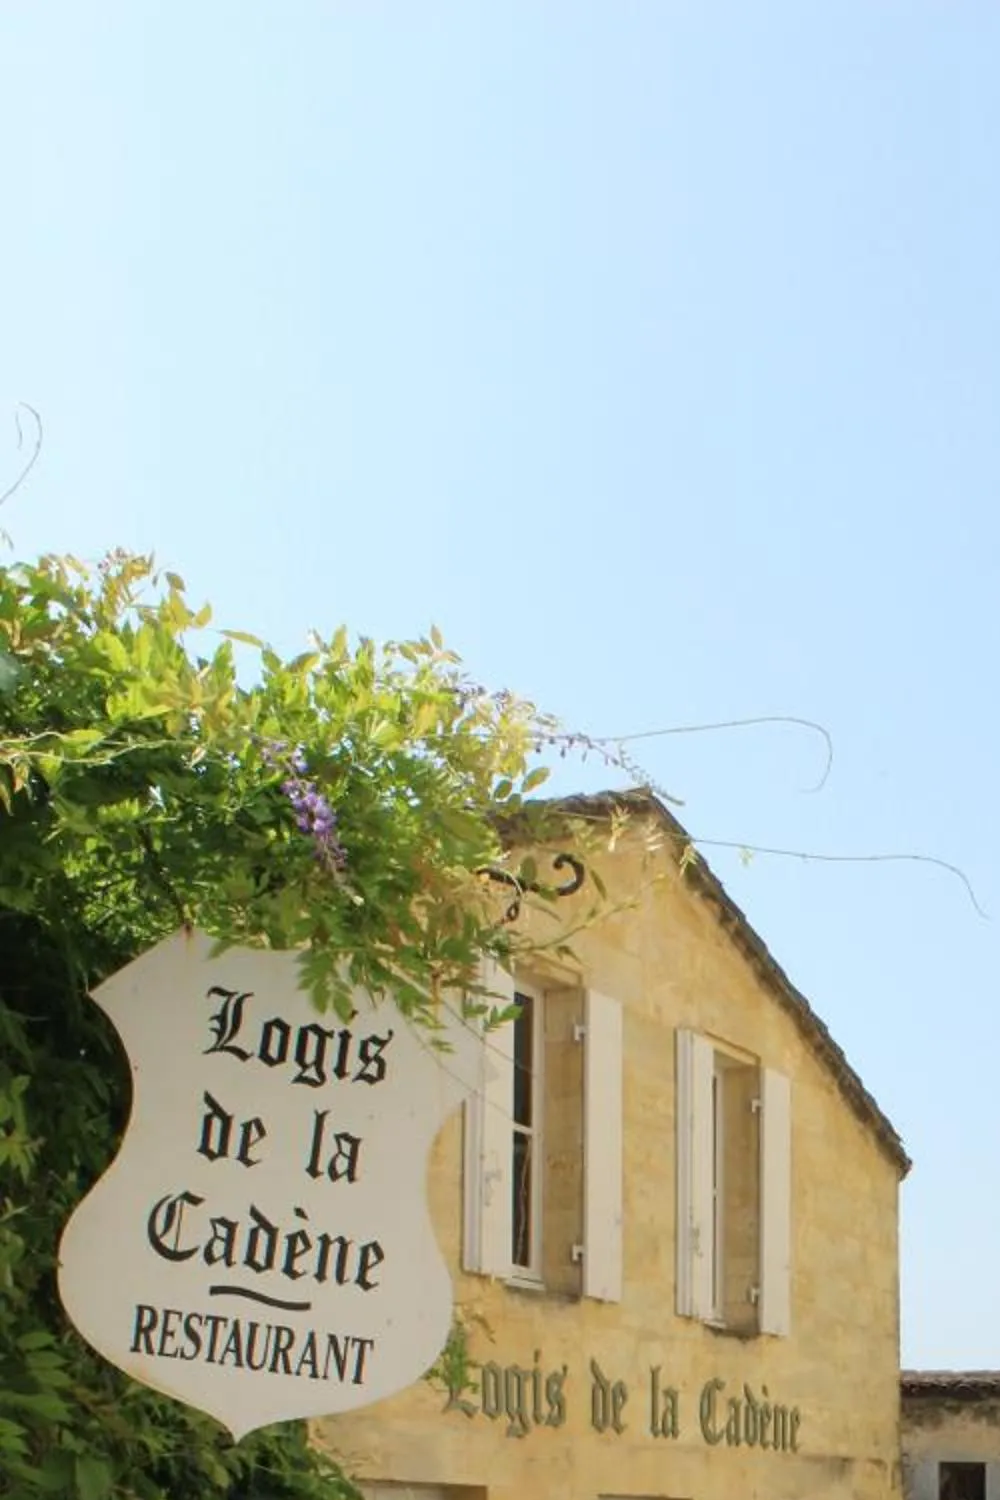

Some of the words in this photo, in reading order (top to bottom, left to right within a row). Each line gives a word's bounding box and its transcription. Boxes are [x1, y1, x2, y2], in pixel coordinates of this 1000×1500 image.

[204, 986, 394, 1088] Logis
[197, 1090, 267, 1168] de
[305, 1109, 362, 1184] la
[147, 1190, 386, 1292] Cadène
[129, 1304, 375, 1385] RESTAURANT
[590, 1357, 630, 1436] de
[649, 1365, 681, 1440] la
[700, 1375, 801, 1454] Cadène
